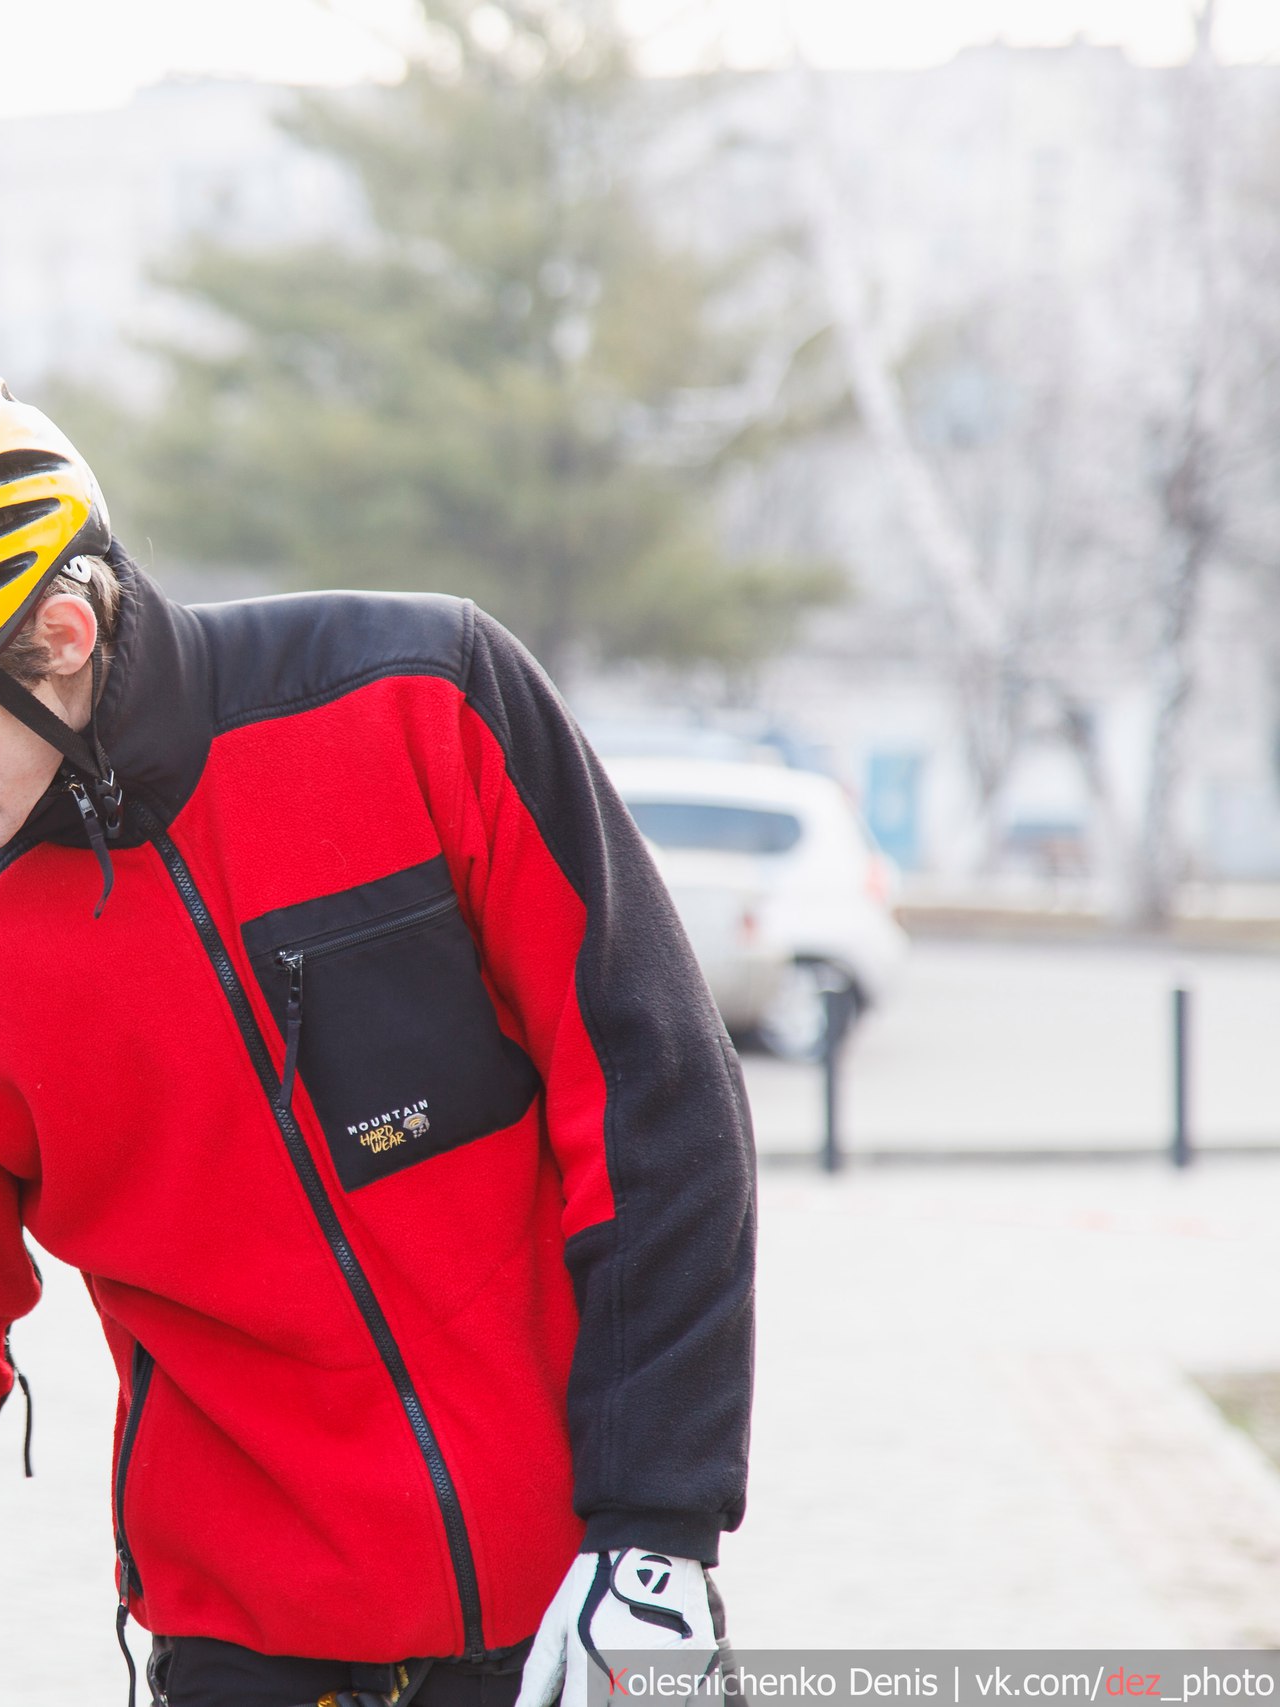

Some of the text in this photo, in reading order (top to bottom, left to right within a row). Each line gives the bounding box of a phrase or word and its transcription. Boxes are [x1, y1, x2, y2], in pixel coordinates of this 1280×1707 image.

[347, 1099, 429, 1136] MOUNTAIN
[360, 1125, 395, 1146] HARD
[370, 1131, 407, 1154] WEAR
